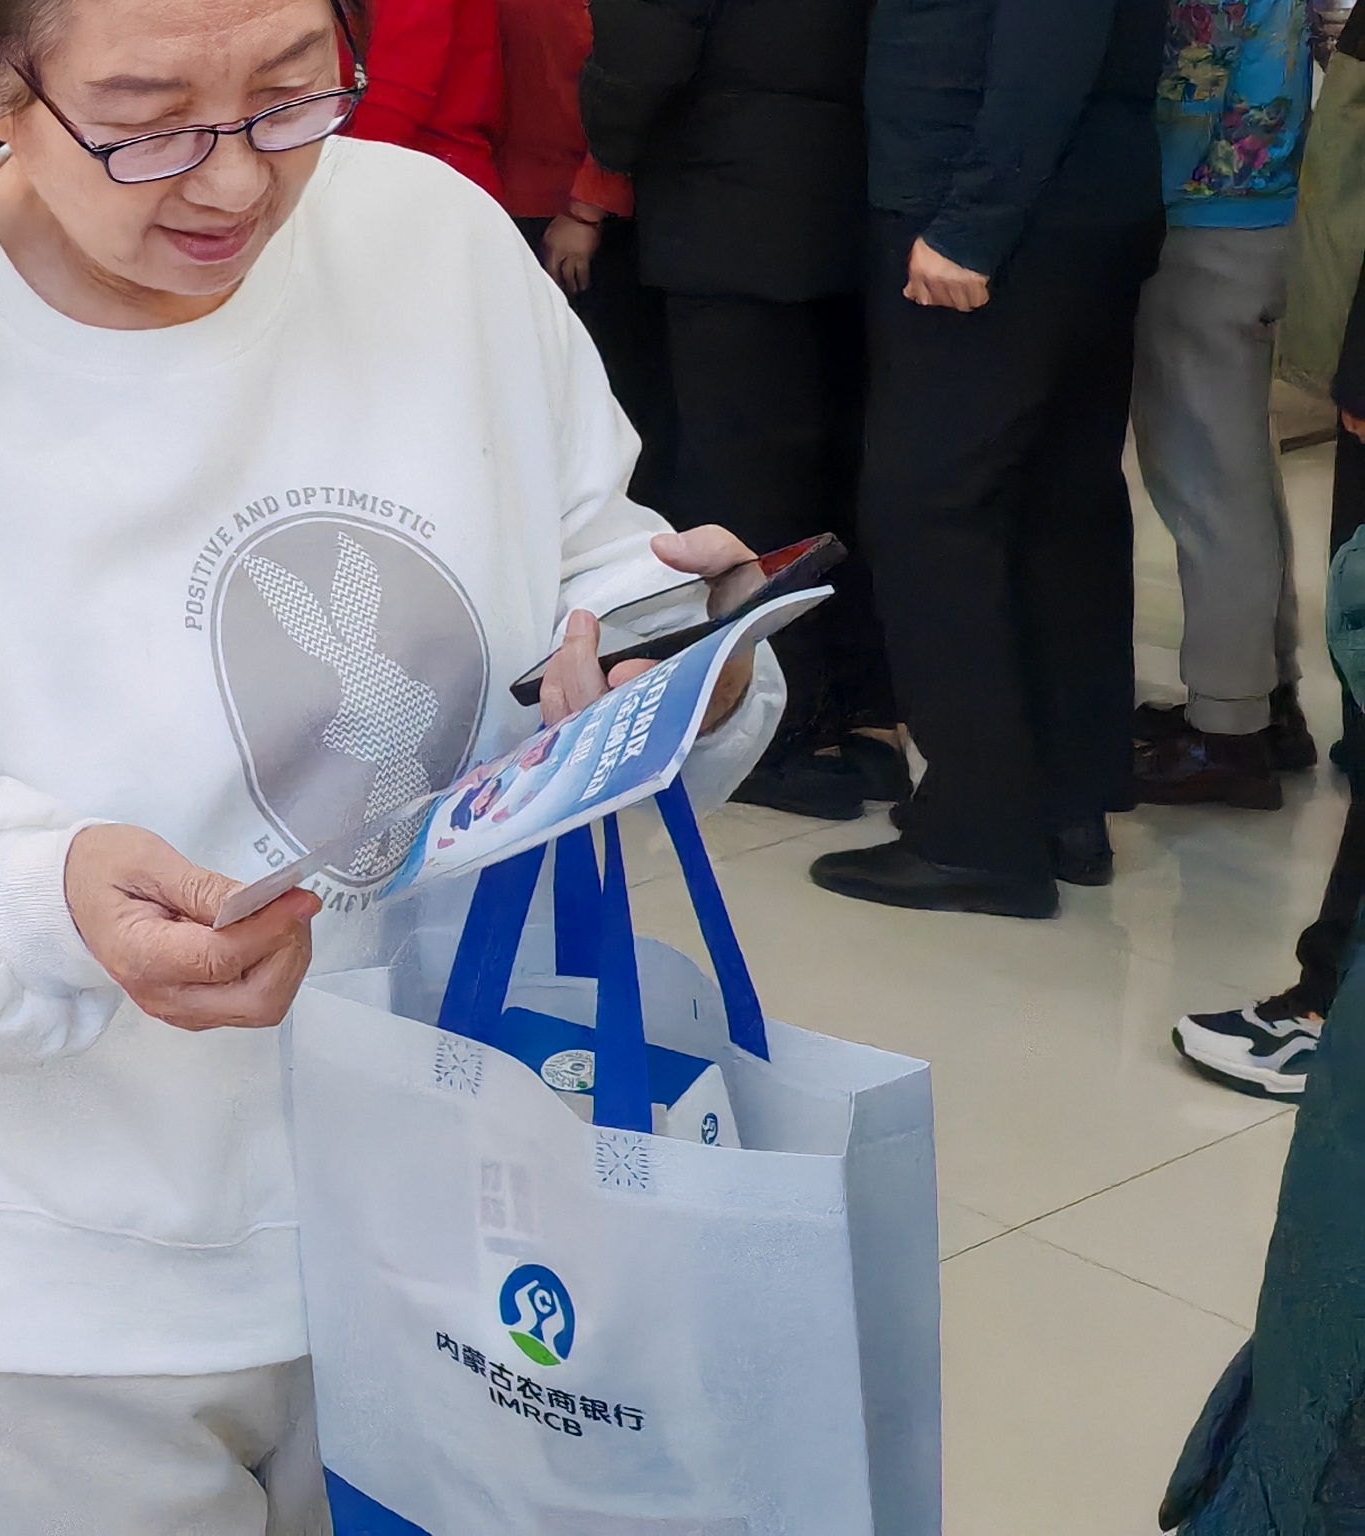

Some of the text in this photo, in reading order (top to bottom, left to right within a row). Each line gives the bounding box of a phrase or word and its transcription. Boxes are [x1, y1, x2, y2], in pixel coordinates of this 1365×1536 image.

[185, 486, 437, 630] POSITIVE AND OPTIMISTIC
[435, 1331, 646, 1432] 内蒙古农商银行
[488, 1386, 584, 1438] IMRCB
